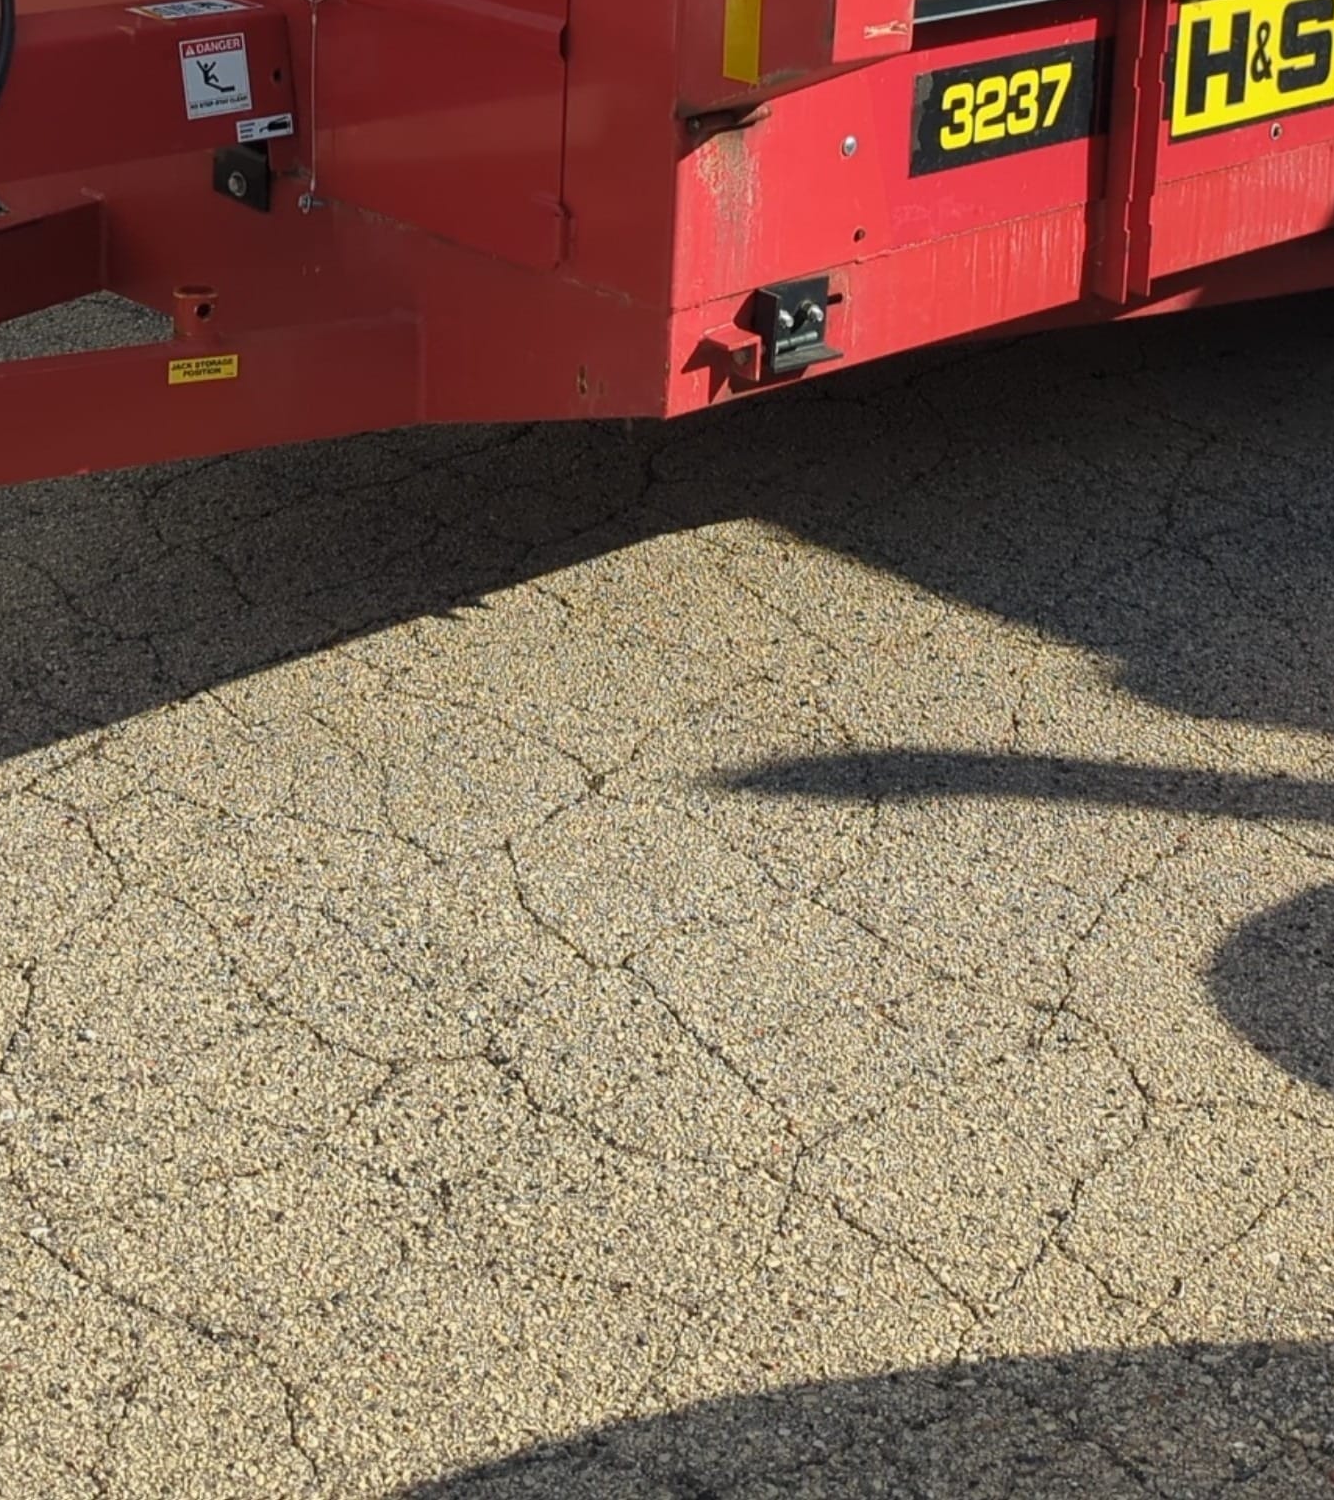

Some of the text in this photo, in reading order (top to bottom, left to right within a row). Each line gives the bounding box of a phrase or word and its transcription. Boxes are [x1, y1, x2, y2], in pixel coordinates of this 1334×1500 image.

[196, 38, 241, 54] DANGER
[940, 62, 1072, 150] 3237
[171, 358, 233, 371] JACK STORAGE
[183, 368, 221, 377] POSITION
